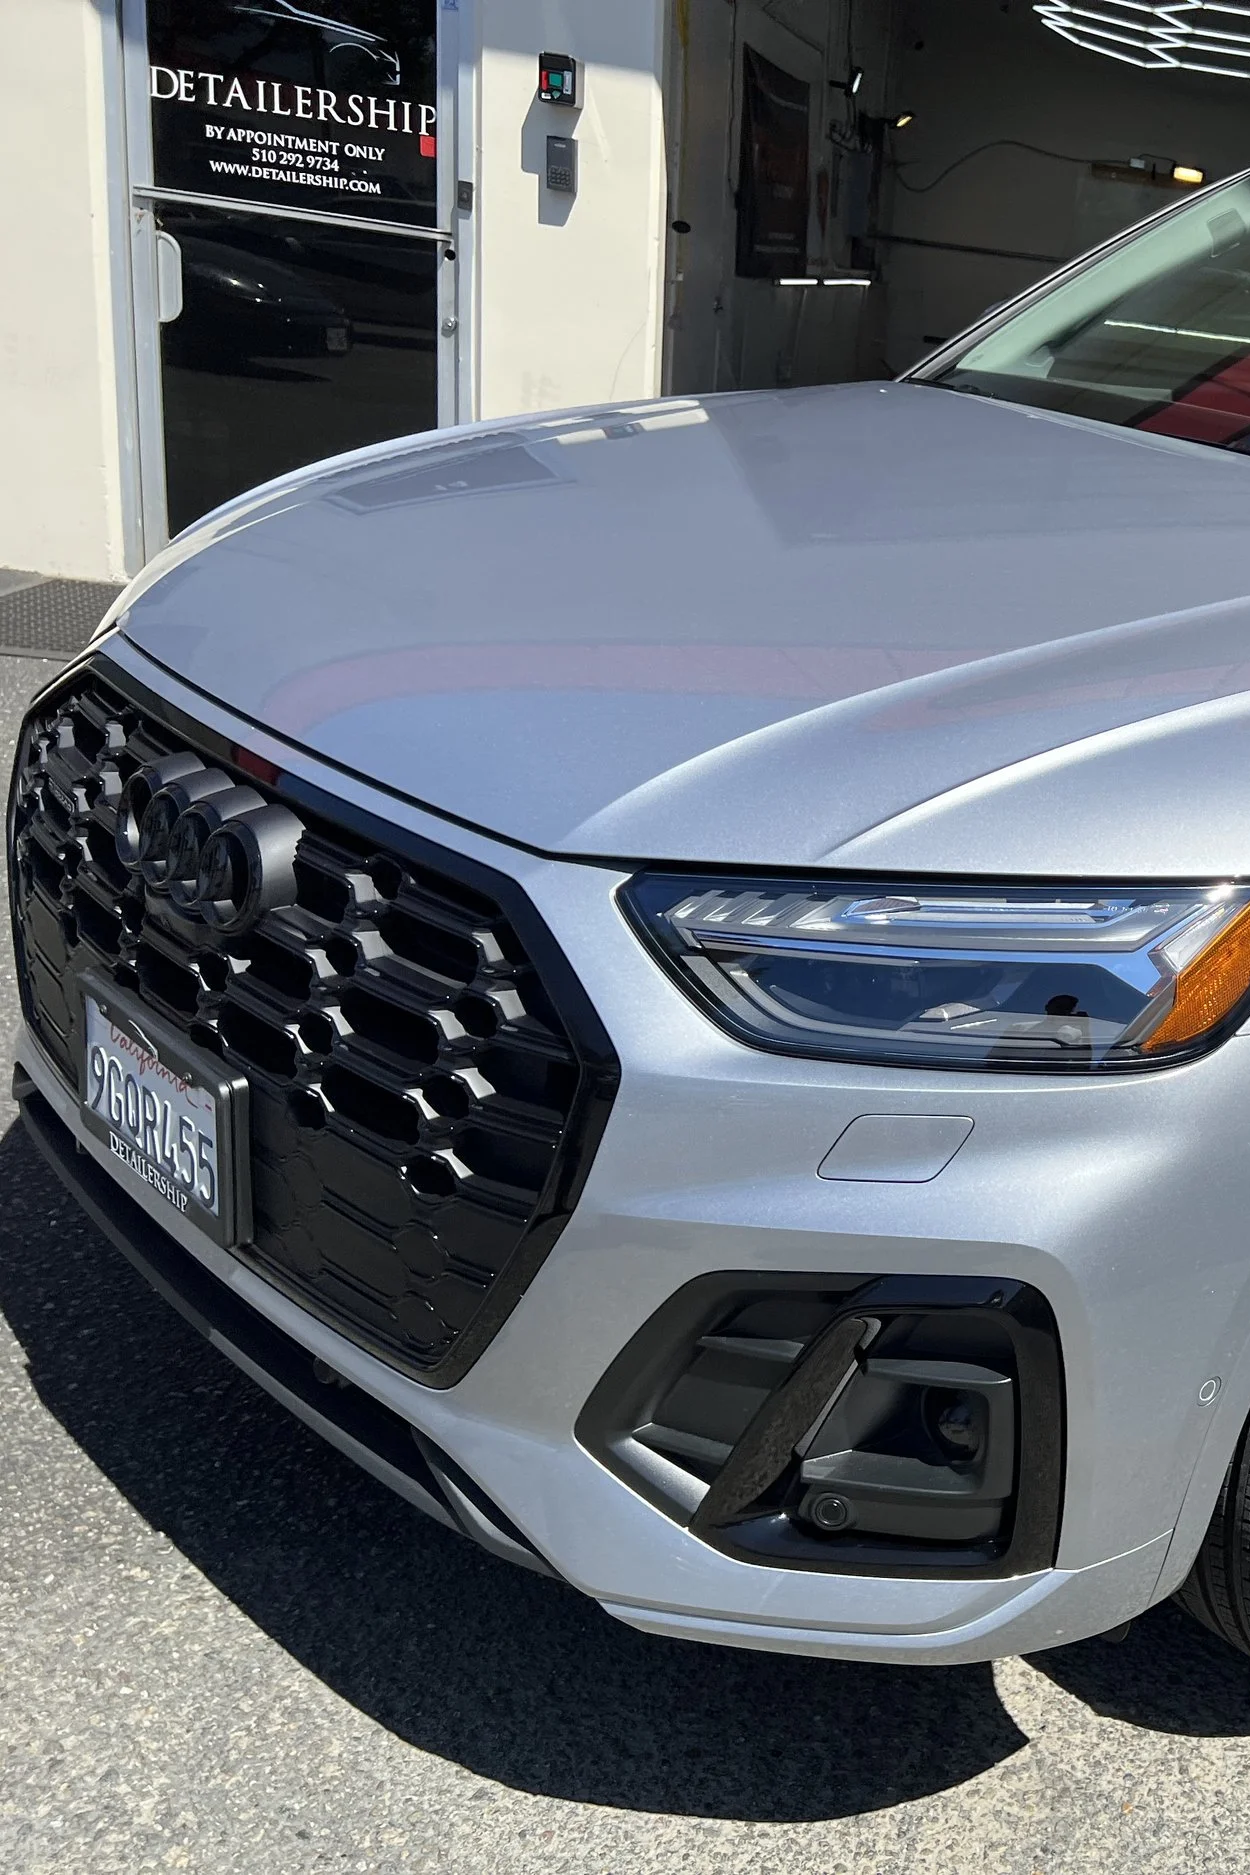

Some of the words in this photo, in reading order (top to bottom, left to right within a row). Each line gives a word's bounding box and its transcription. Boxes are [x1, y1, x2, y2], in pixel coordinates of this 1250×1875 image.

[150, 65, 437, 136] DETAILERSHIP
[205, 124, 226, 140] BY
[226, 128, 340, 155] APPOINTMENT
[344, 143, 386, 161] ONLY
[252, 147, 277, 163] 510
[279, 151, 305, 168] 292
[306, 155, 340, 172] 9734
[209, 160, 382, 194] WWW.DETAILERSHIP.COM
[91, 1045, 215, 1209] 9GQR455
[109, 1131, 188, 1213] DETAILERSHIP
